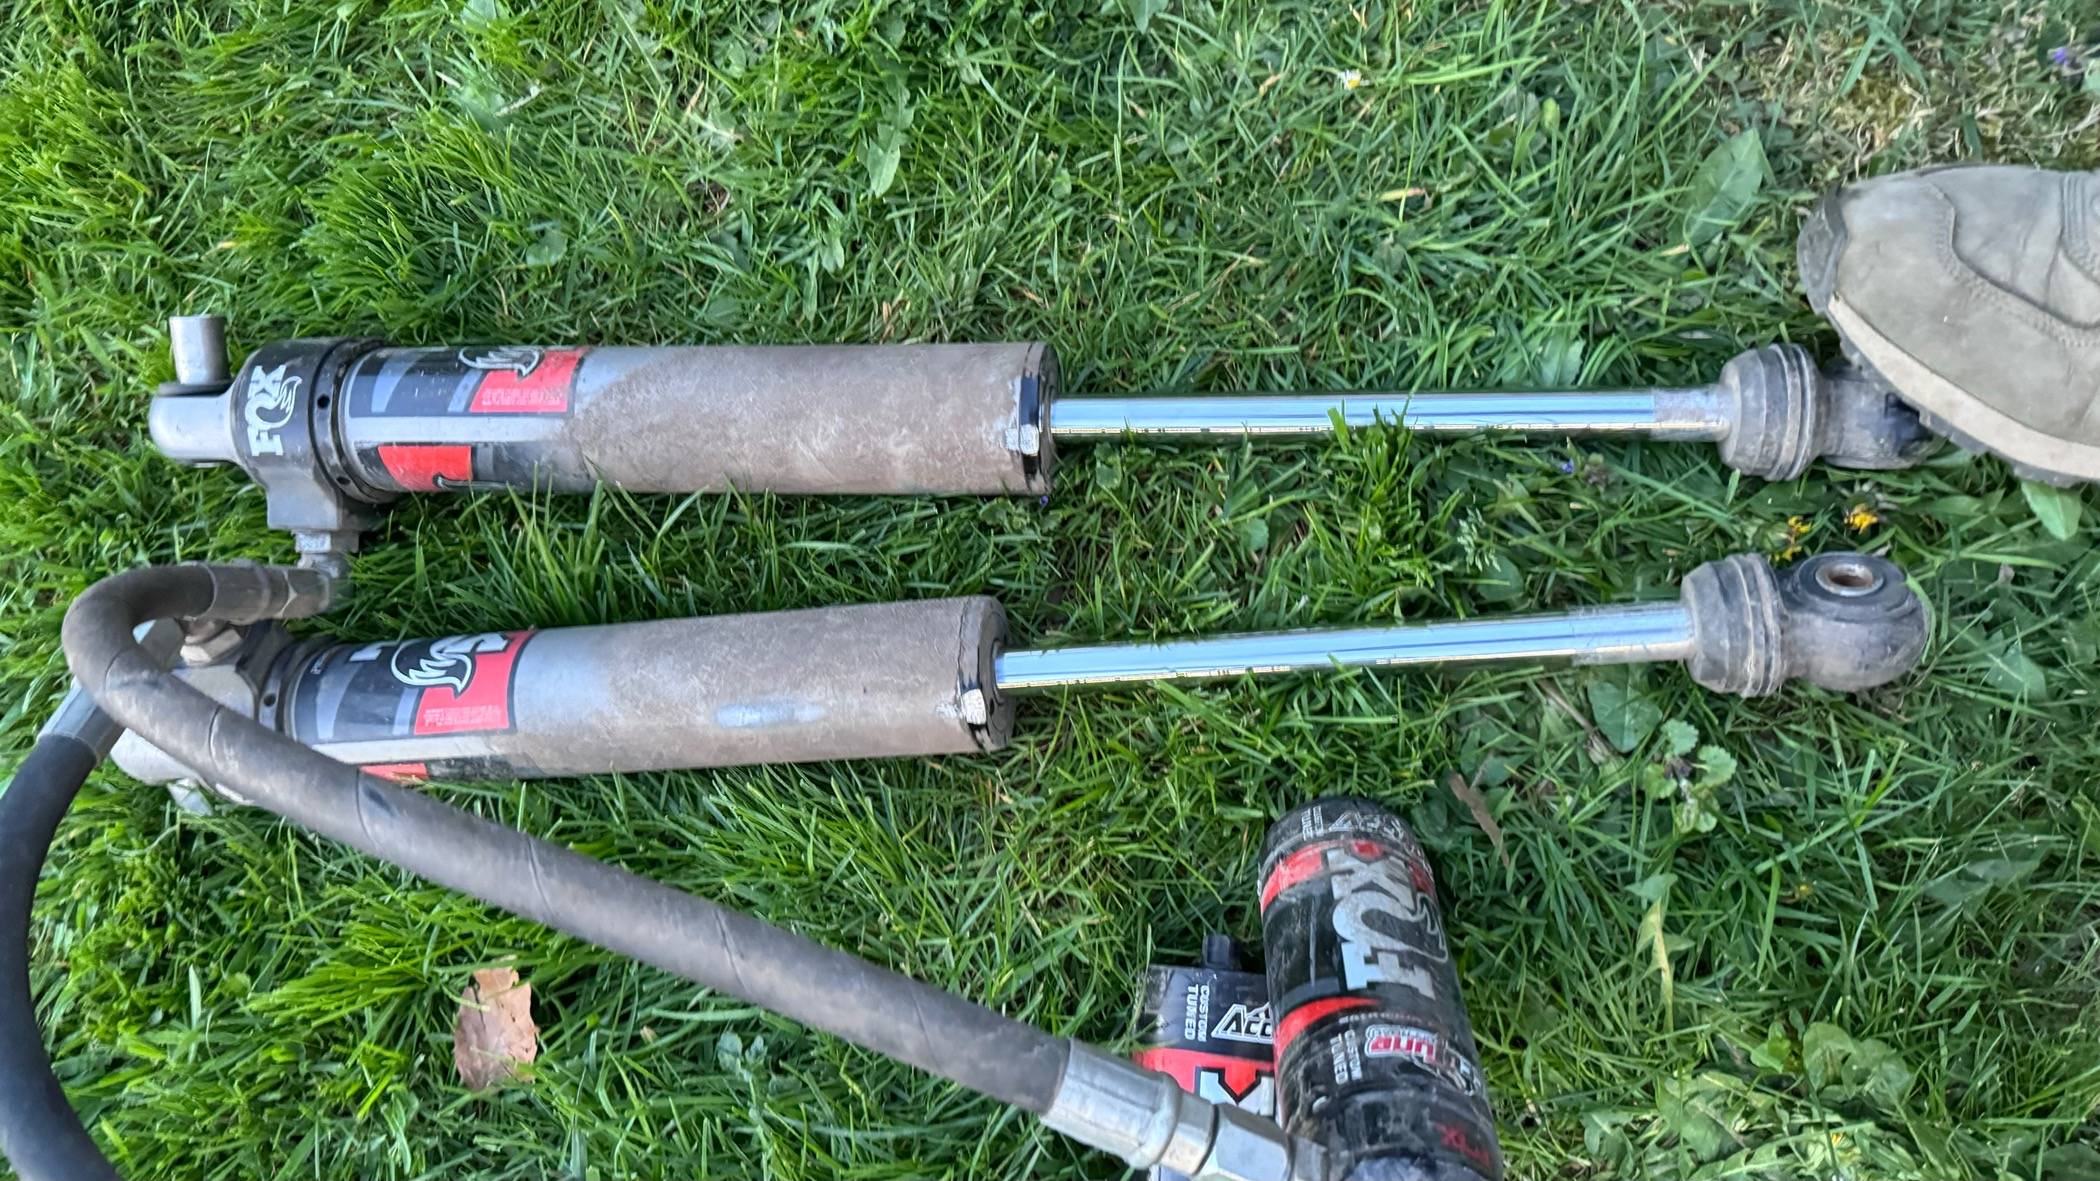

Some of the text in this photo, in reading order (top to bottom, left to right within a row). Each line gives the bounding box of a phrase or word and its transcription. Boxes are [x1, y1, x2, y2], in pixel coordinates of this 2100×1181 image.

[244, 364, 302, 457] FOX
[1326, 848, 1449, 1000] FOX
[1184, 984, 1200, 1040] TUNED
[1197, 985, 1210, 1042] CUSTOM
[1330, 1033, 1349, 1085] TUNED
